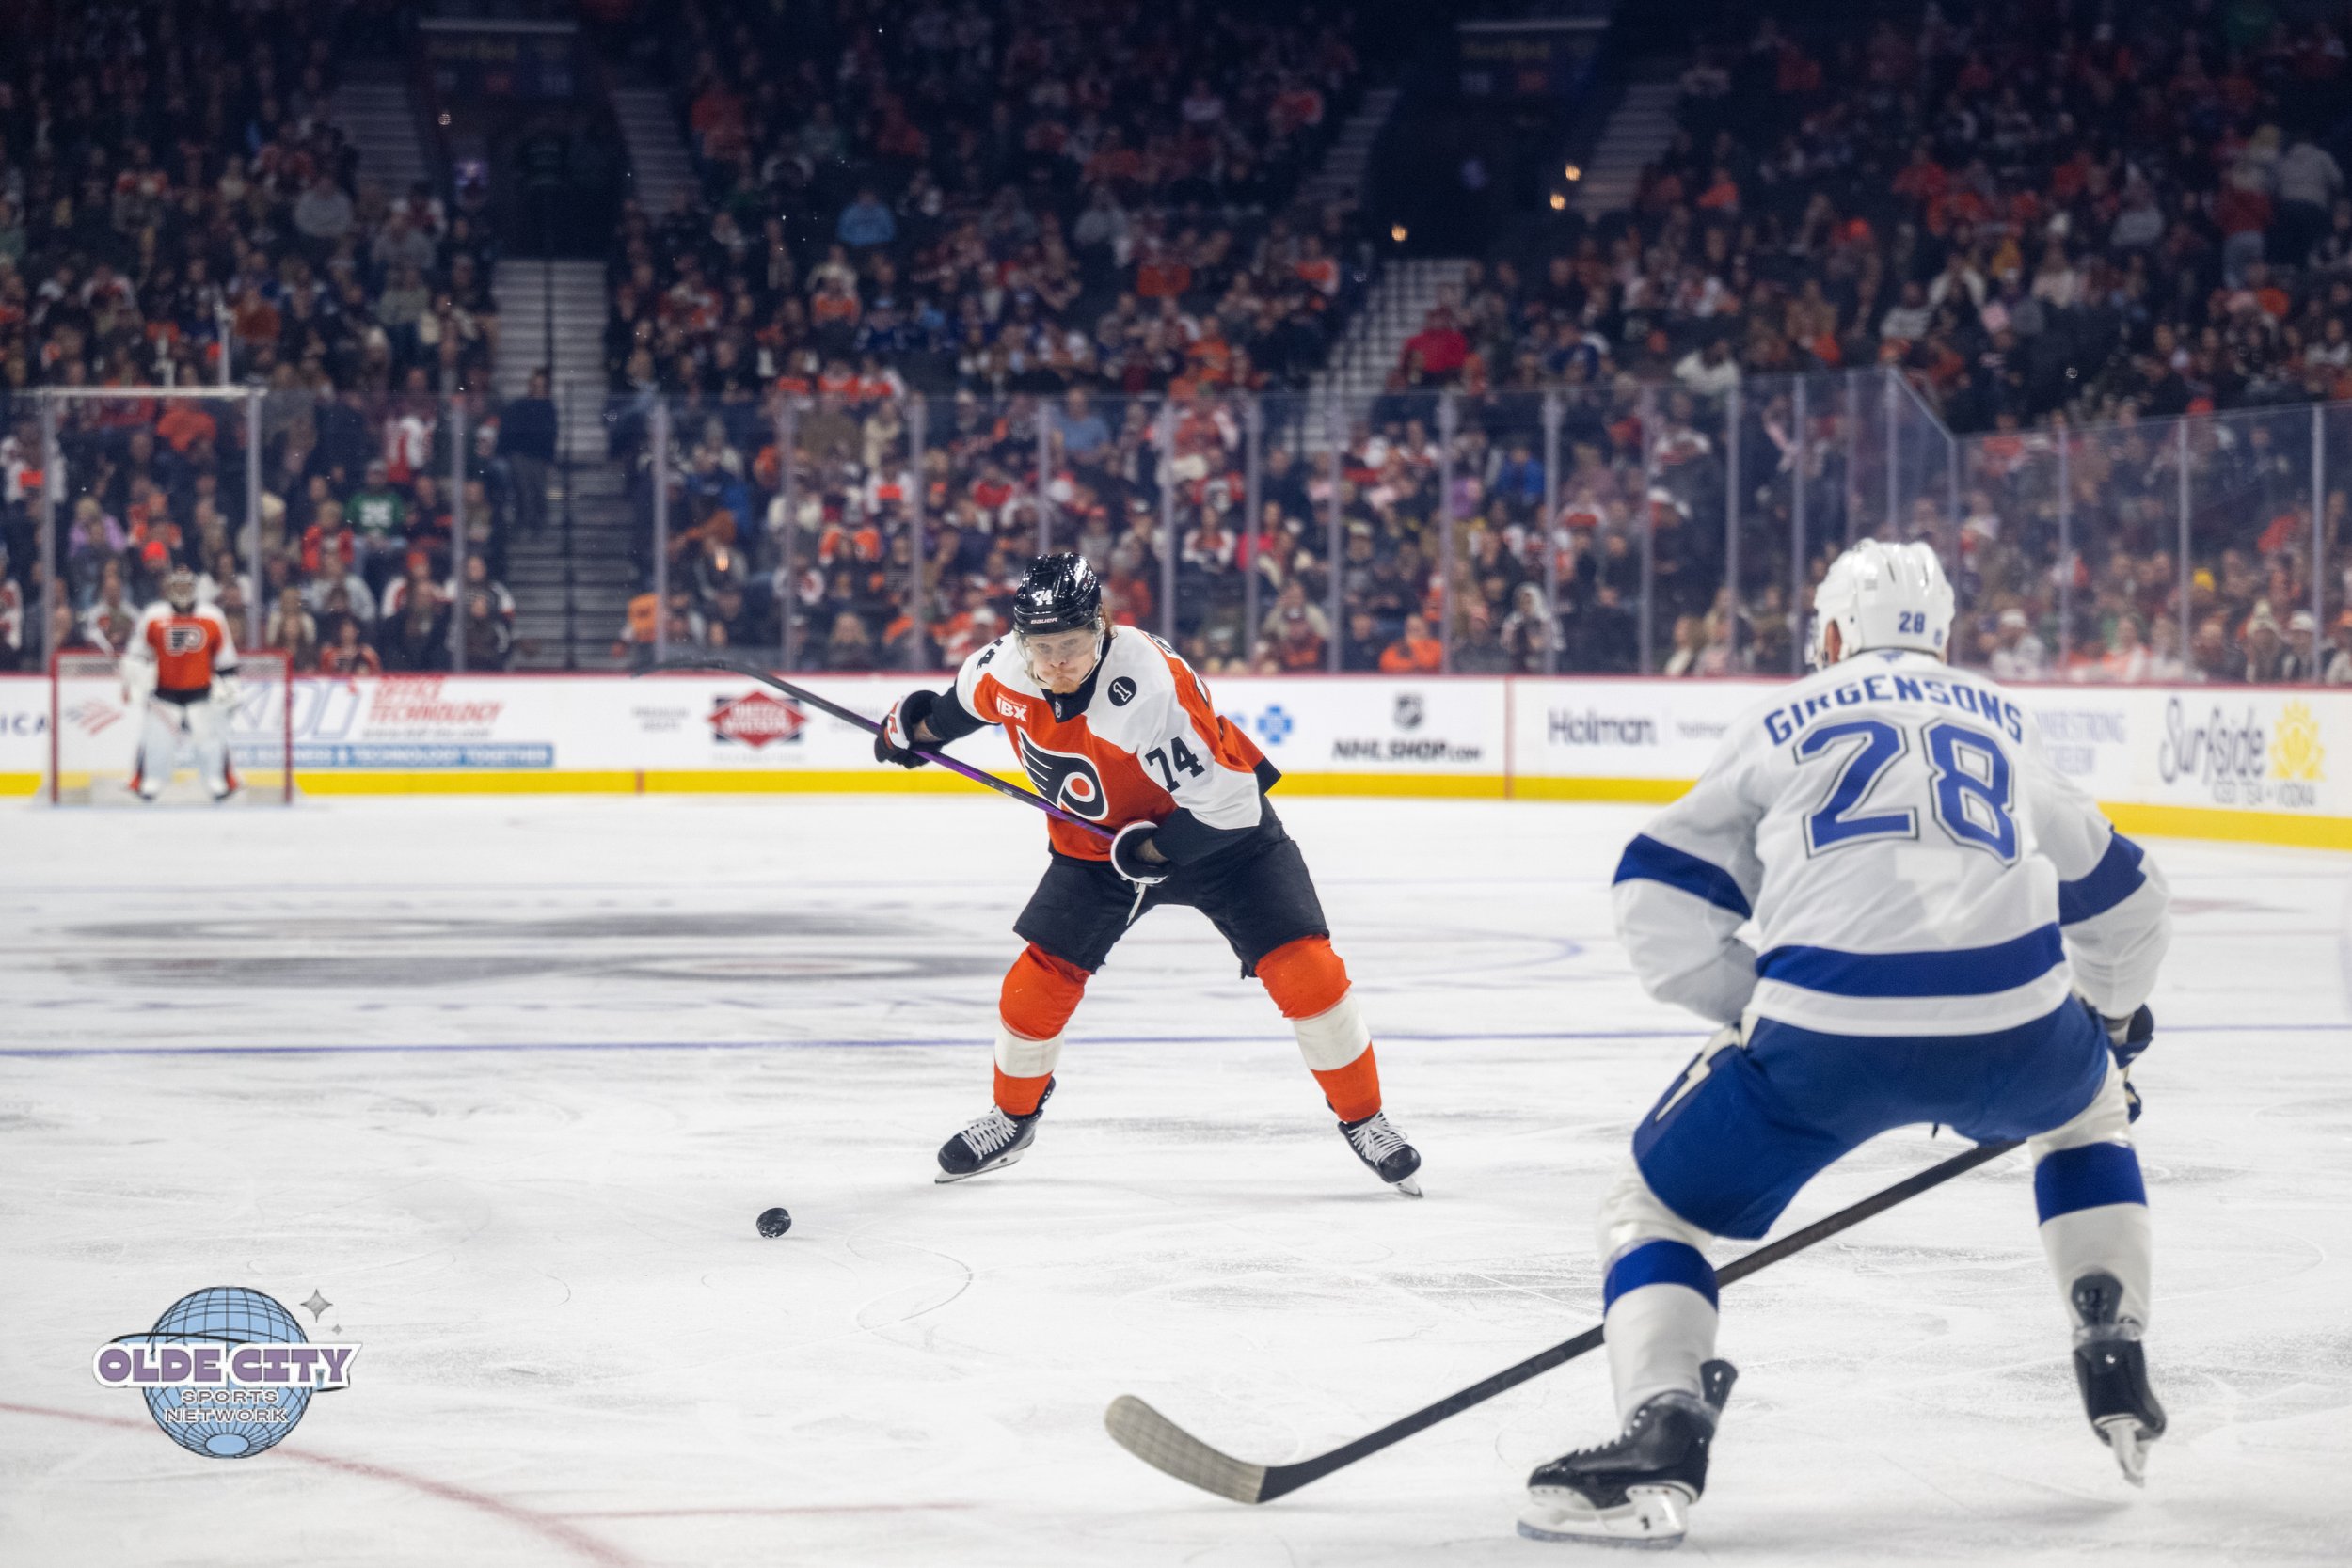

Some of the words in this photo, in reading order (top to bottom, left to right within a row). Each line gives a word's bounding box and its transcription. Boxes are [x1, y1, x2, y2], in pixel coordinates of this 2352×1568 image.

[1035, 590, 1053, 606] 74
[1899, 611, 1926, 633] 28
[1113, 682, 1132, 703] 1
[368, 702, 504, 724] TECHNOLOGY
[996, 697, 1027, 722] IBX
[1764, 675, 2023, 746] GIRGENSONS
[1547, 708, 1657, 744] Holman
[2159, 696, 2265, 785] Surfside
[1145, 736, 1205, 793] 74
[1793, 716, 2022, 868] 28
